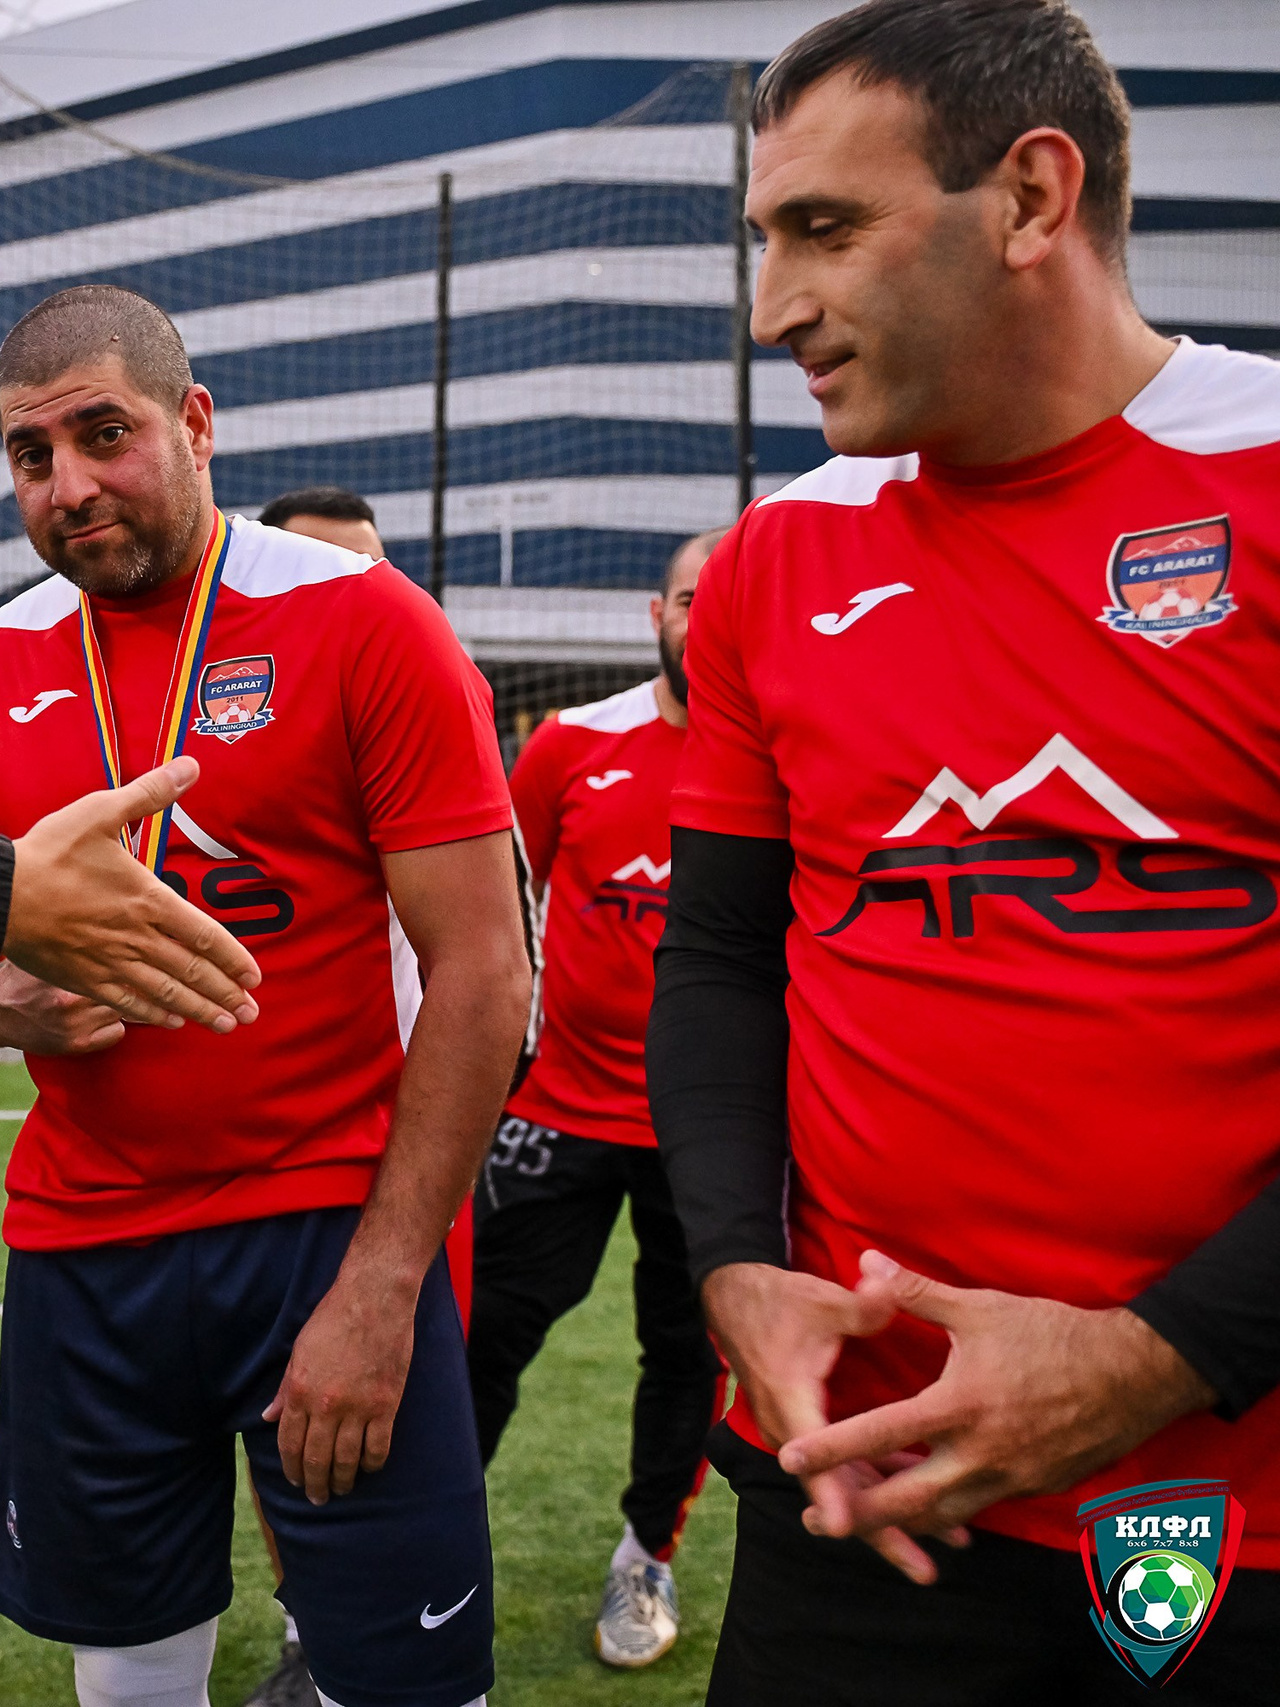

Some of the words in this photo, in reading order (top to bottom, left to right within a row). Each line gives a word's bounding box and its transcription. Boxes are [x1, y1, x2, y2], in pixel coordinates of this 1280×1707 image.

[1129, 565, 1150, 577] FC
[1153, 554, 1215, 573] ARARAT
[224, 681, 262, 692] ARARAT
[207, 722, 257, 733] KALININGRAD
[814, 838, 1278, 939] ARS
[491, 1117, 558, 1176] 95
